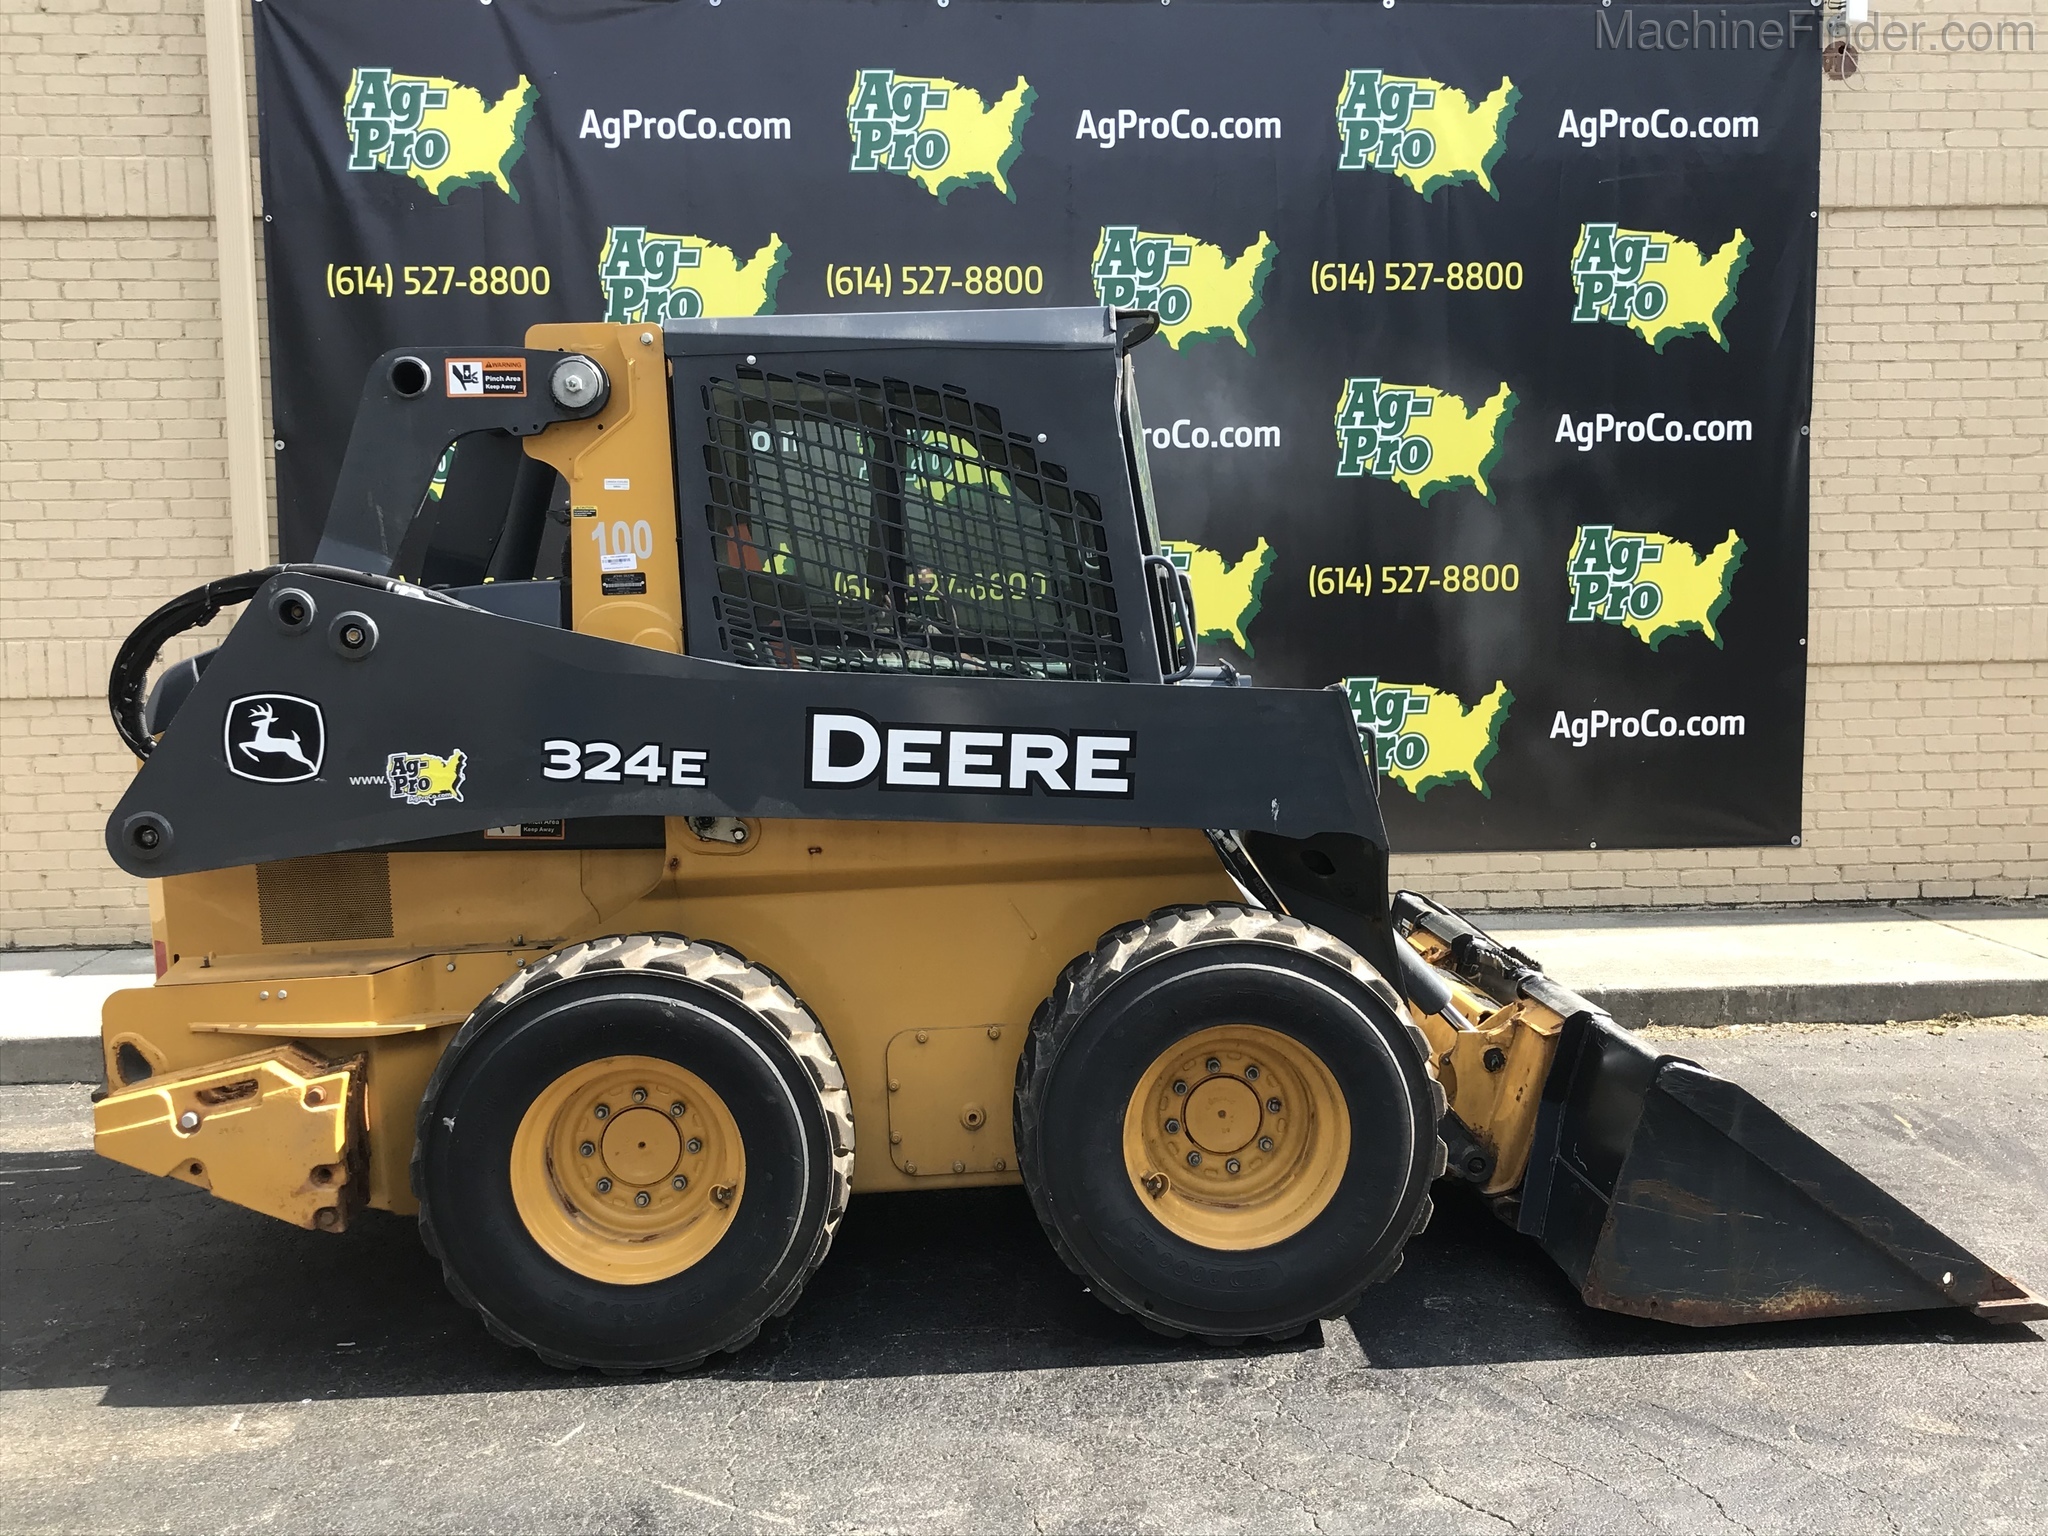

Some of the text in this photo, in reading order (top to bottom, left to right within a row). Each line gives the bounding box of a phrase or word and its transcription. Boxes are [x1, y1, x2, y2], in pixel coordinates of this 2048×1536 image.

[347, 69, 448, 128] Ag-
[850, 70, 948, 129] Ag-
[1337, 70, 1435, 129] Ag-
[348, 120, 450, 170] Pro
[579, 108, 791, 149] AgProCo.com
[851, 120, 950, 170] Pro
[1075, 108, 1282, 149] AgProCo.com
[1338, 120, 1435, 170] Pro
[1557, 108, 1759, 148] AgProCo.com
[602, 226, 701, 287] Ag-
[1095, 225, 1191, 287] Ag-
[1311, 260, 1523, 293] (614) 527-8800
[1573, 223, 1668, 284] Ag-
[326, 264, 550, 297] (614) 527-8800
[604, 278, 703, 324] Pro
[826, 264, 1043, 297] (614) 527-8800
[1573, 272, 1666, 323] Pro
[1337, 379, 1433, 438] Ag-
[1141, 418, 1281, 450] roCo.com
[1337, 428, 1433, 477] Pro
[1554, 412, 1752, 452] AgProCo.com
[591, 519, 653, 560] 100
[1567, 525, 1664, 584] Ag-
[1309, 563, 1520, 597] (614) 527-8800
[1568, 575, 1662, 622] Pro
[1347, 676, 1430, 734] Ag-
[1549, 708, 1745, 747] AgProCo.com
[391, 755, 429, 777] Ag-
[543, 740, 707, 786] 324E
[811, 713, 1131, 793] DEERE
[349, 775, 388, 786] www.
[392, 775, 432, 796] Pro
